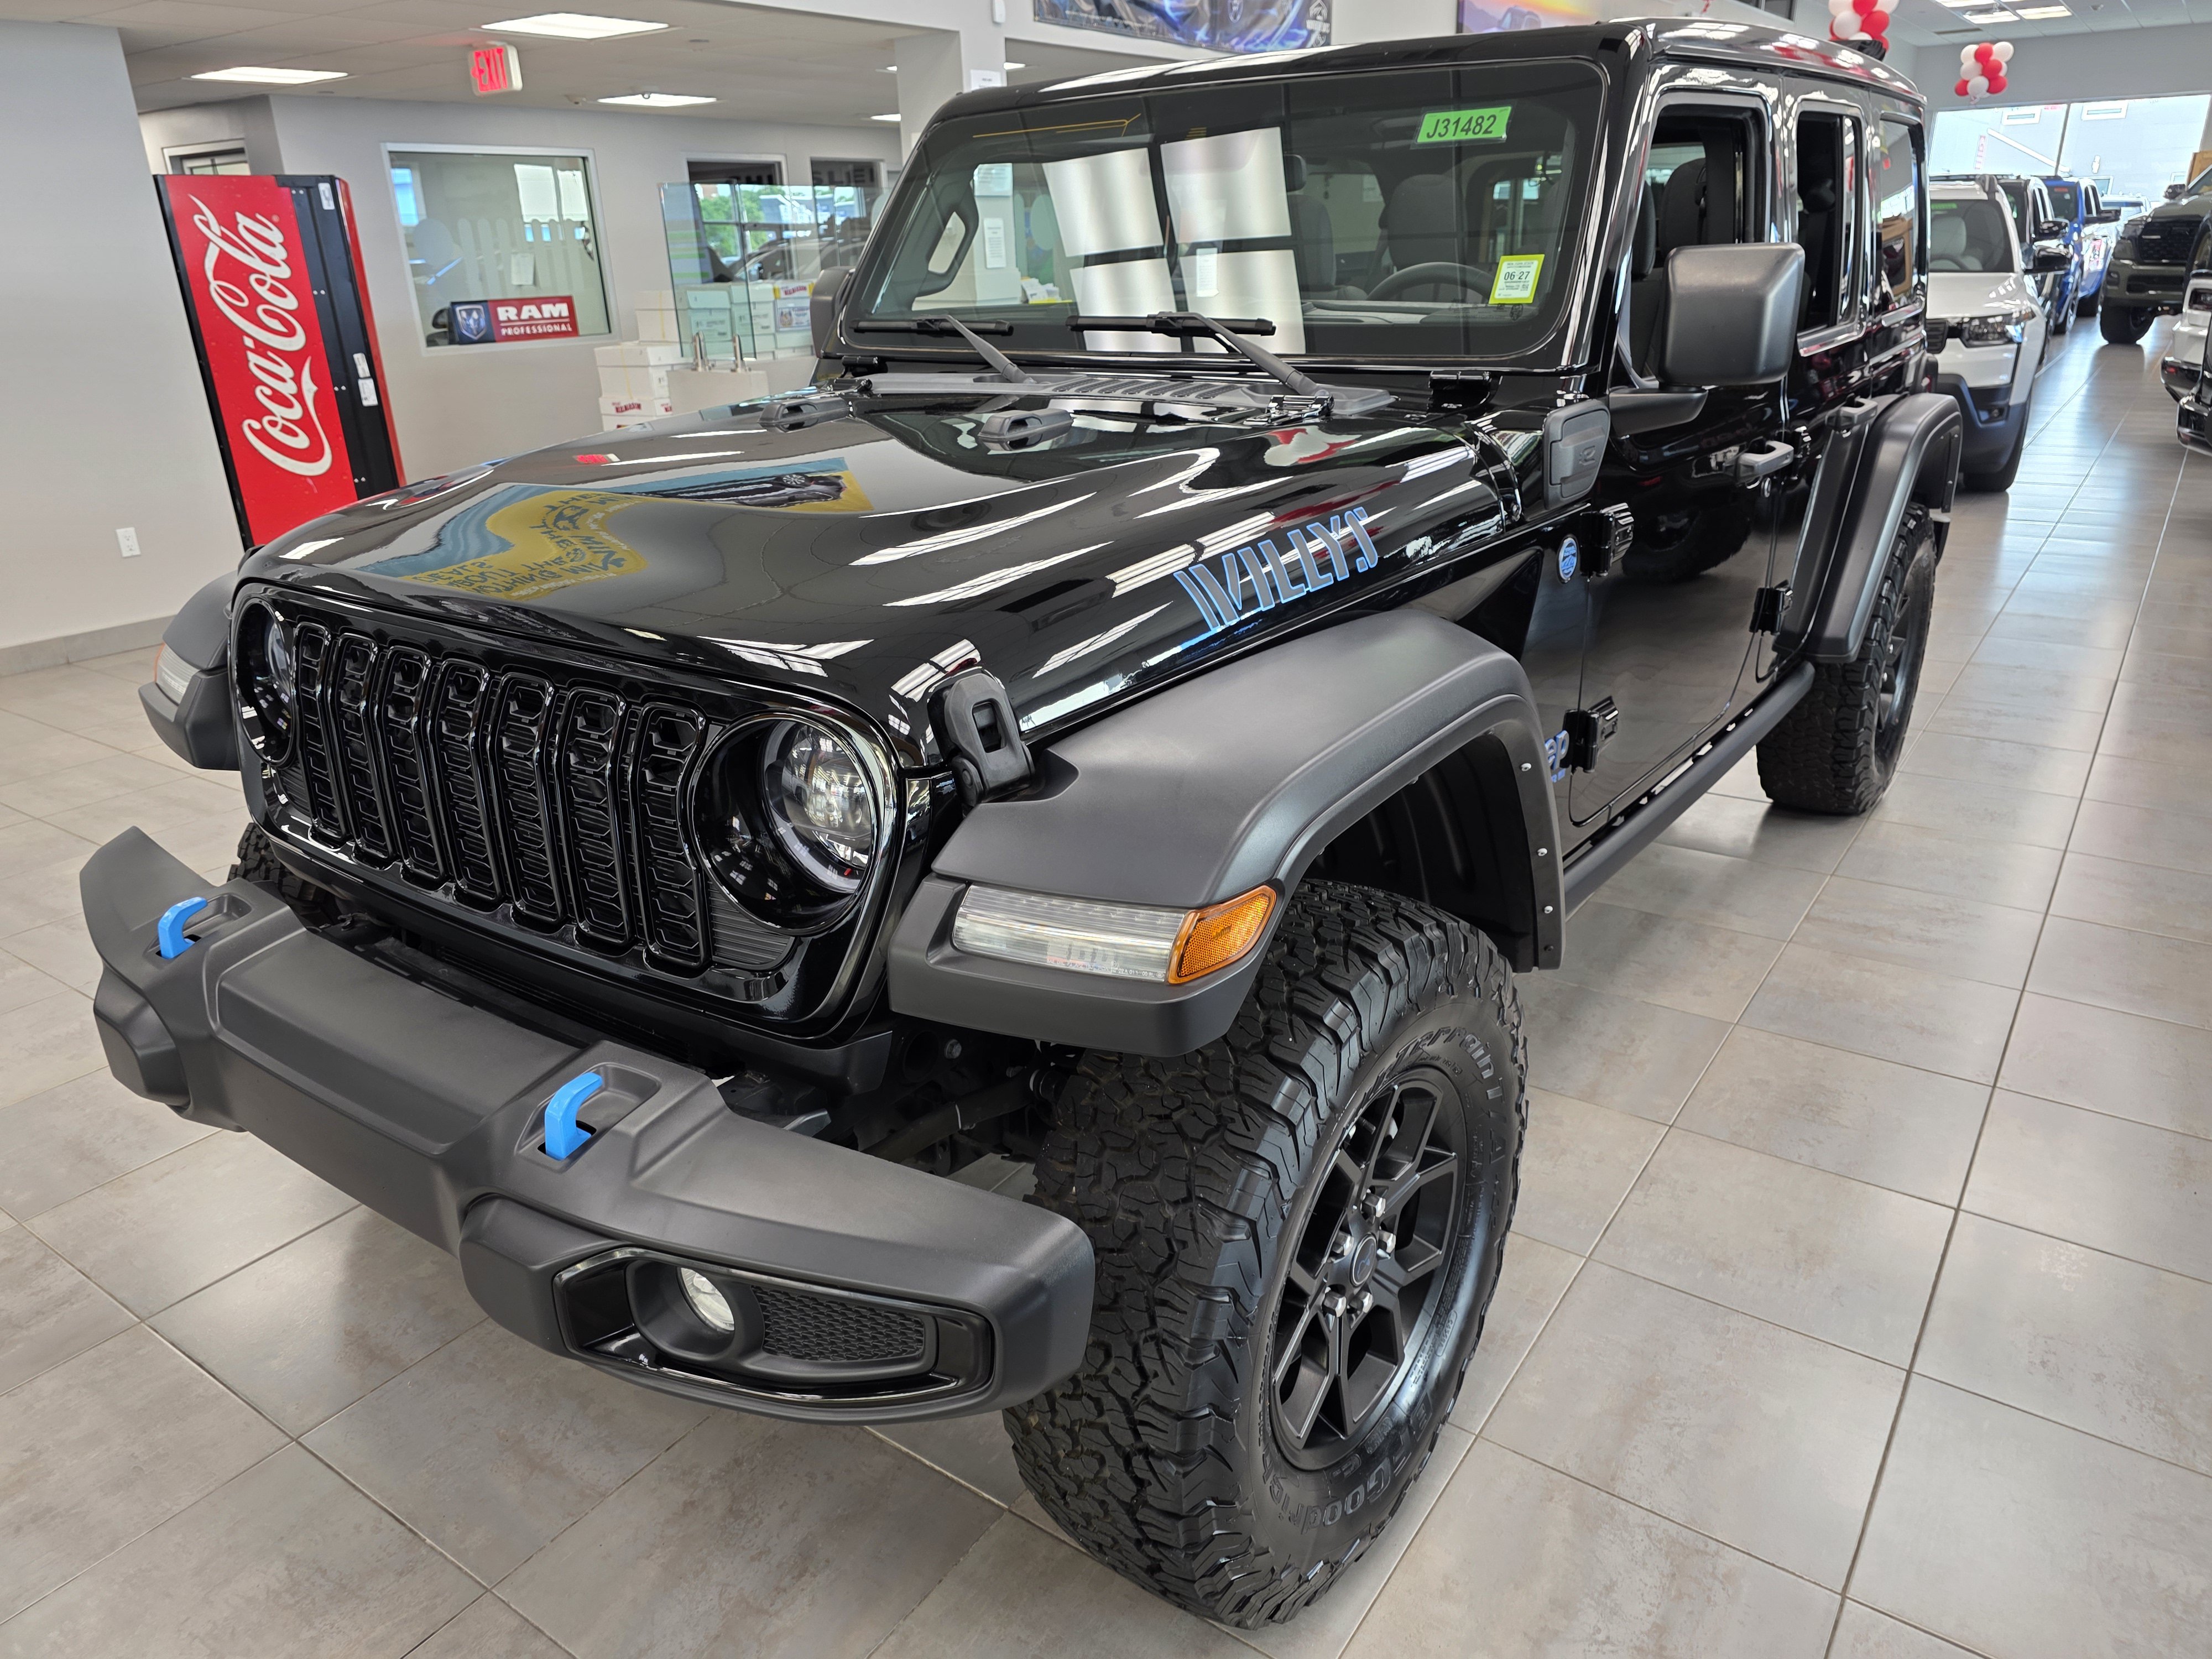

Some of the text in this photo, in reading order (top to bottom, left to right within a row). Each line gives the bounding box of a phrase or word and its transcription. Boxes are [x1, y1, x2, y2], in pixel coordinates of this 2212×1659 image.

[473, 48, 508, 92] EXIT
[1426, 114, 1497, 139] J31482
[497, 302, 570, 321] RAM
[188, 194, 332, 476] Coca-Cola
[500, 323, 572, 336] PROFESSIONAL
[1172, 506, 1379, 632] WILLYS
